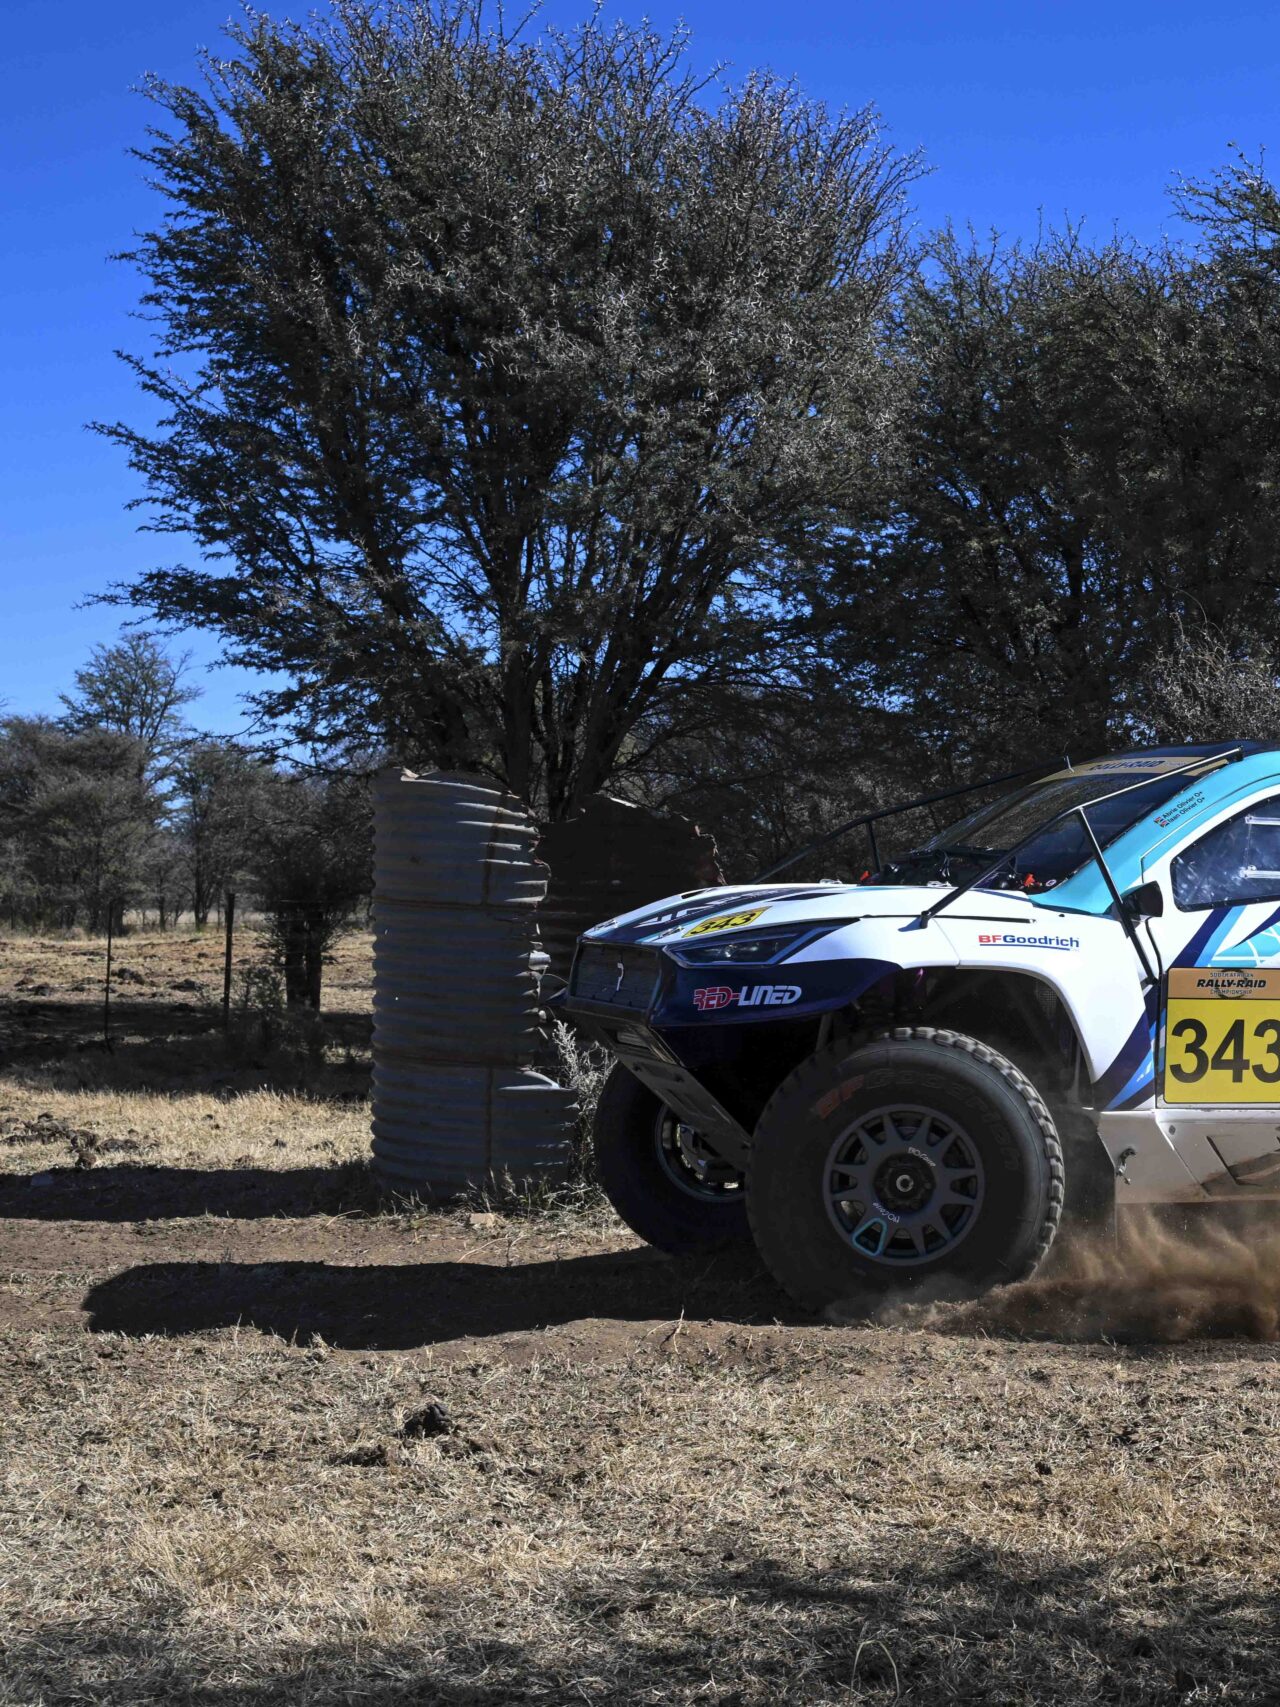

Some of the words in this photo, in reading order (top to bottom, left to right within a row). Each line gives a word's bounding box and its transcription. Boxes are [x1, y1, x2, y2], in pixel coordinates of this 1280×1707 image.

[690, 911, 757, 936] 343
[978, 934, 1080, 948] BFGoodrich
[1196, 978, 1267, 988] RALLY-RAID
[693, 984, 803, 1011] RED-LINED
